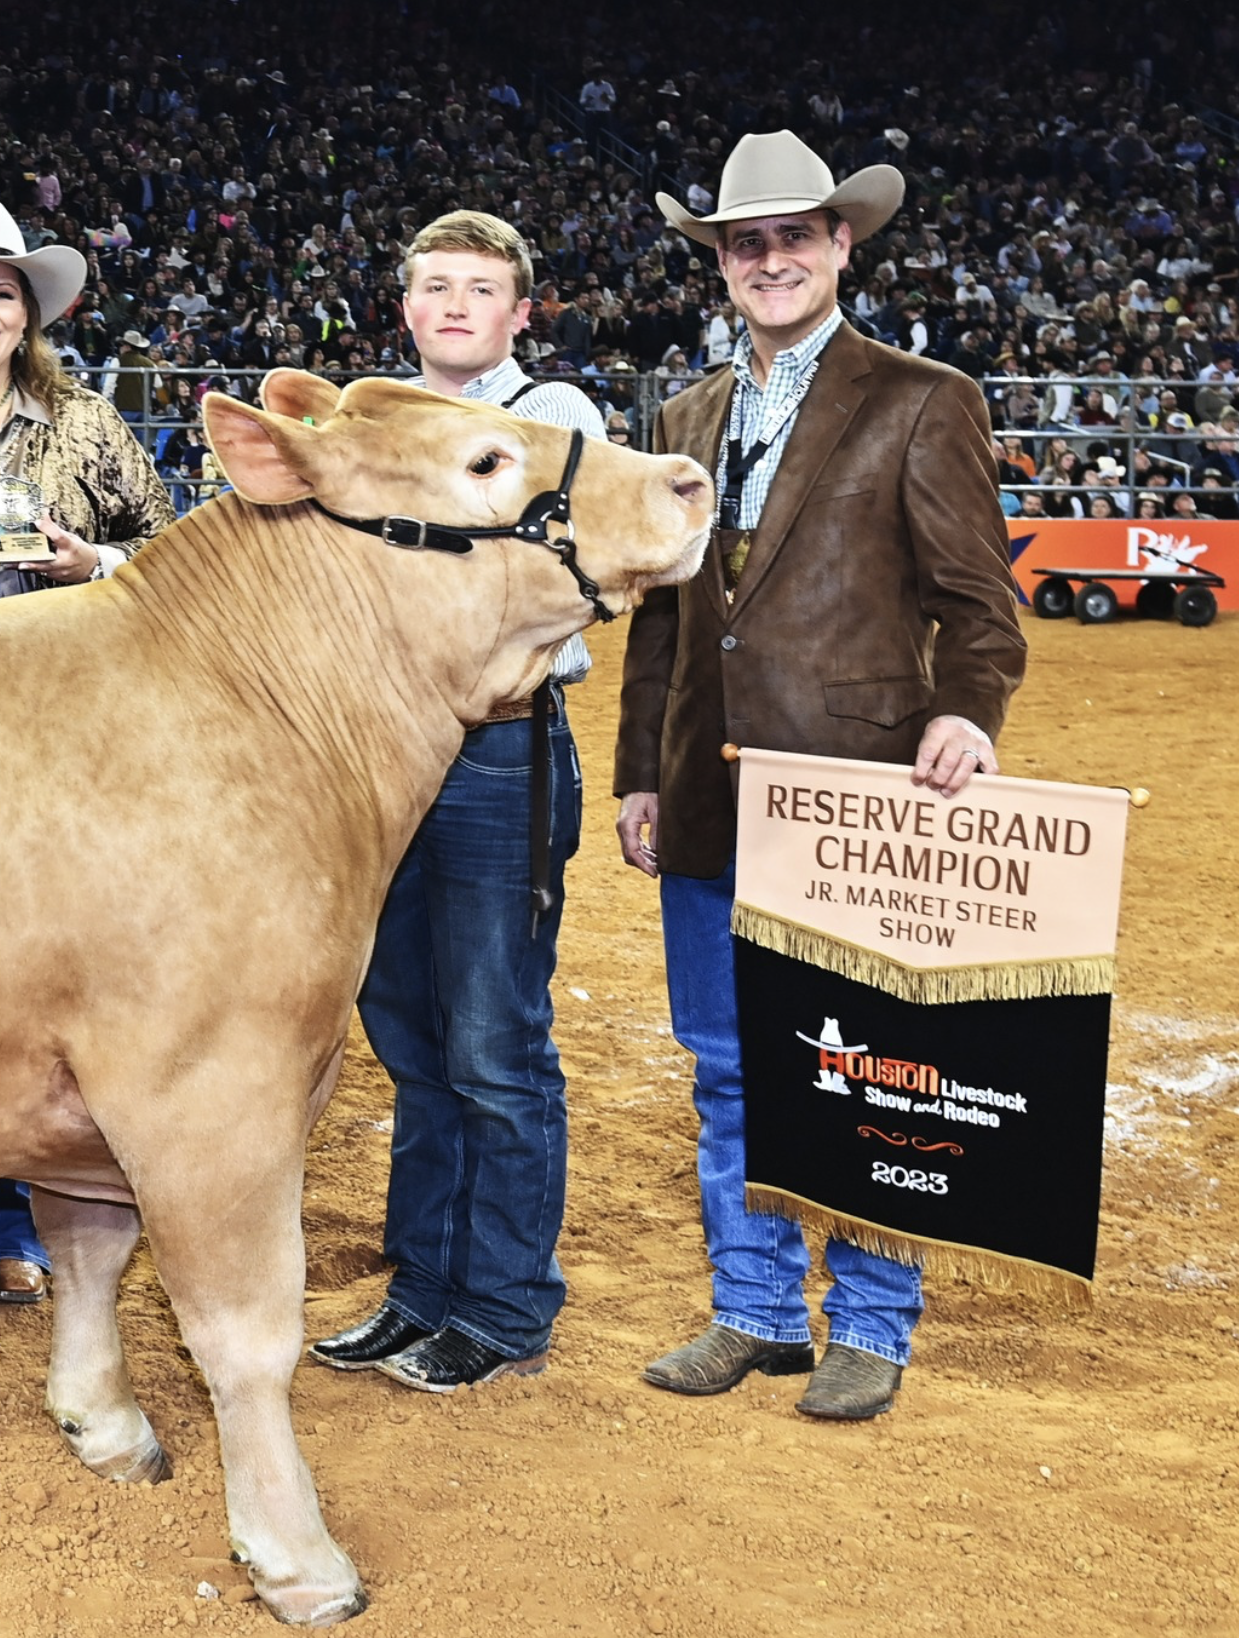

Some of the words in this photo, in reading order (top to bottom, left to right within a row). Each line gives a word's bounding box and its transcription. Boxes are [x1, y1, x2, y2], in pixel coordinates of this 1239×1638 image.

[766, 783, 936, 838] RESERVE
[946, 806, 1092, 857] GRAND
[815, 835, 1031, 896] CHAMPION
[804, 880, 838, 904] JR.
[846, 885, 950, 919] MARKET
[955, 900, 1037, 932] STEER
[879, 917, 956, 949] SHOW
[864, 1085, 912, 1112] Show
[913, 1099, 942, 1115] and
[944, 1100, 1000, 1128] Rodeo
[941, 1078, 1028, 1114] Livestock
[871, 1161, 949, 1195] 2023
